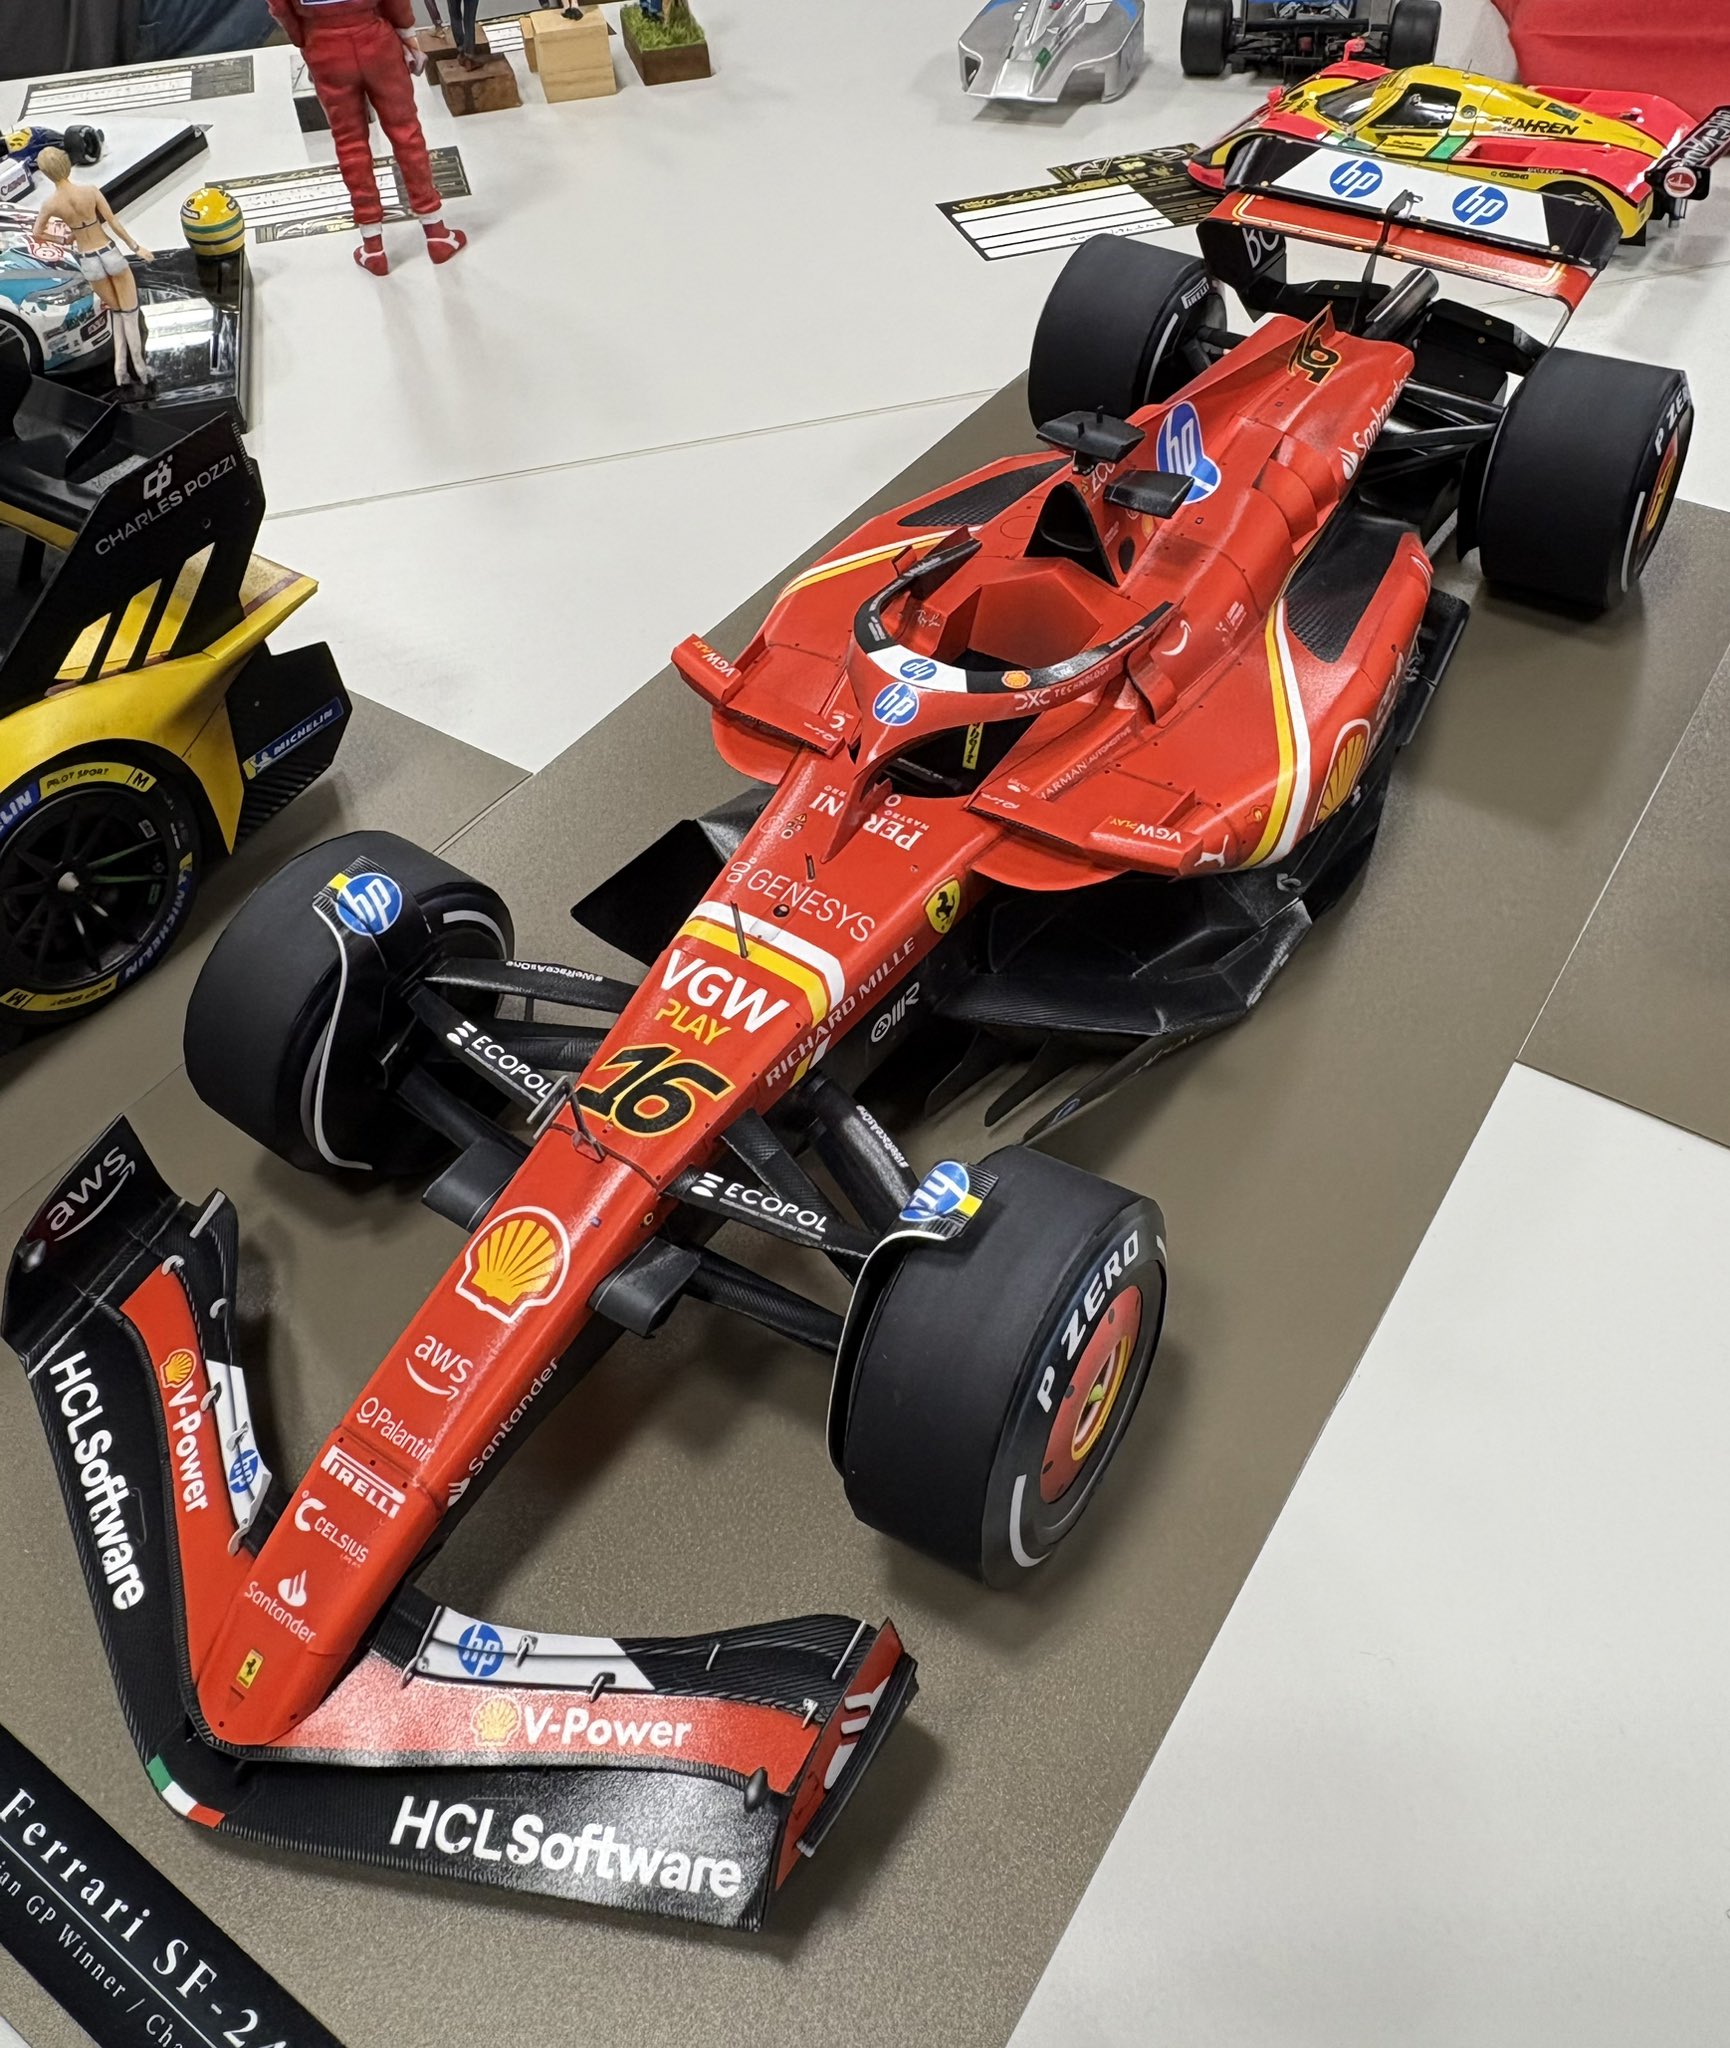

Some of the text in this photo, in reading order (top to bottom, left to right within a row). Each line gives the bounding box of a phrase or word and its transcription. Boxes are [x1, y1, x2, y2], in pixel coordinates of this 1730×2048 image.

[1331, 159, 1382, 198] hp
[1453, 185, 1507, 225] hp
[95, 454, 238, 555] CHARLES POZZI
[273, 708, 335, 757] MICHELIN
[873, 682, 919, 726] hp
[132, 772, 150, 788] M
[1134, 823, 1183, 845] VGW
[336, 873, 402, 936] hp
[747, 868, 876, 943] GENESYS
[654, 998, 734, 1047] PLAY
[661, 948, 790, 1034] VGW
[765, 937, 917, 1088] RICHARD MILLE
[470, 1034, 555, 1099] ECOPOL
[573, 1043, 737, 1138] 16
[46, 1145, 127, 1233] aws
[724, 1182, 828, 1234] ECOPOL
[1036, 1229, 1140, 1414] P ZERO
[414, 1334, 474, 1386] aws
[168, 1380, 209, 1513] V-Power
[467, 1357, 561, 1476] Santander
[50, 1350, 146, 1611] HCLSoftware
[227, 1448, 258, 1494] hp
[320, 1443, 406, 1520] PIRELLI
[313, 1518, 369, 1565] CELSIUS
[244, 1580, 317, 1645] Santander
[459, 1622, 504, 1678] hp
[523, 1704, 694, 1750] V-Power
[0, 1787, 151, 1943] Ferrari
[389, 1795, 743, 1901] HCLSoftware
[25, 1894, 57, 1925] GP
[57, 1922, 126, 1998] Winner
